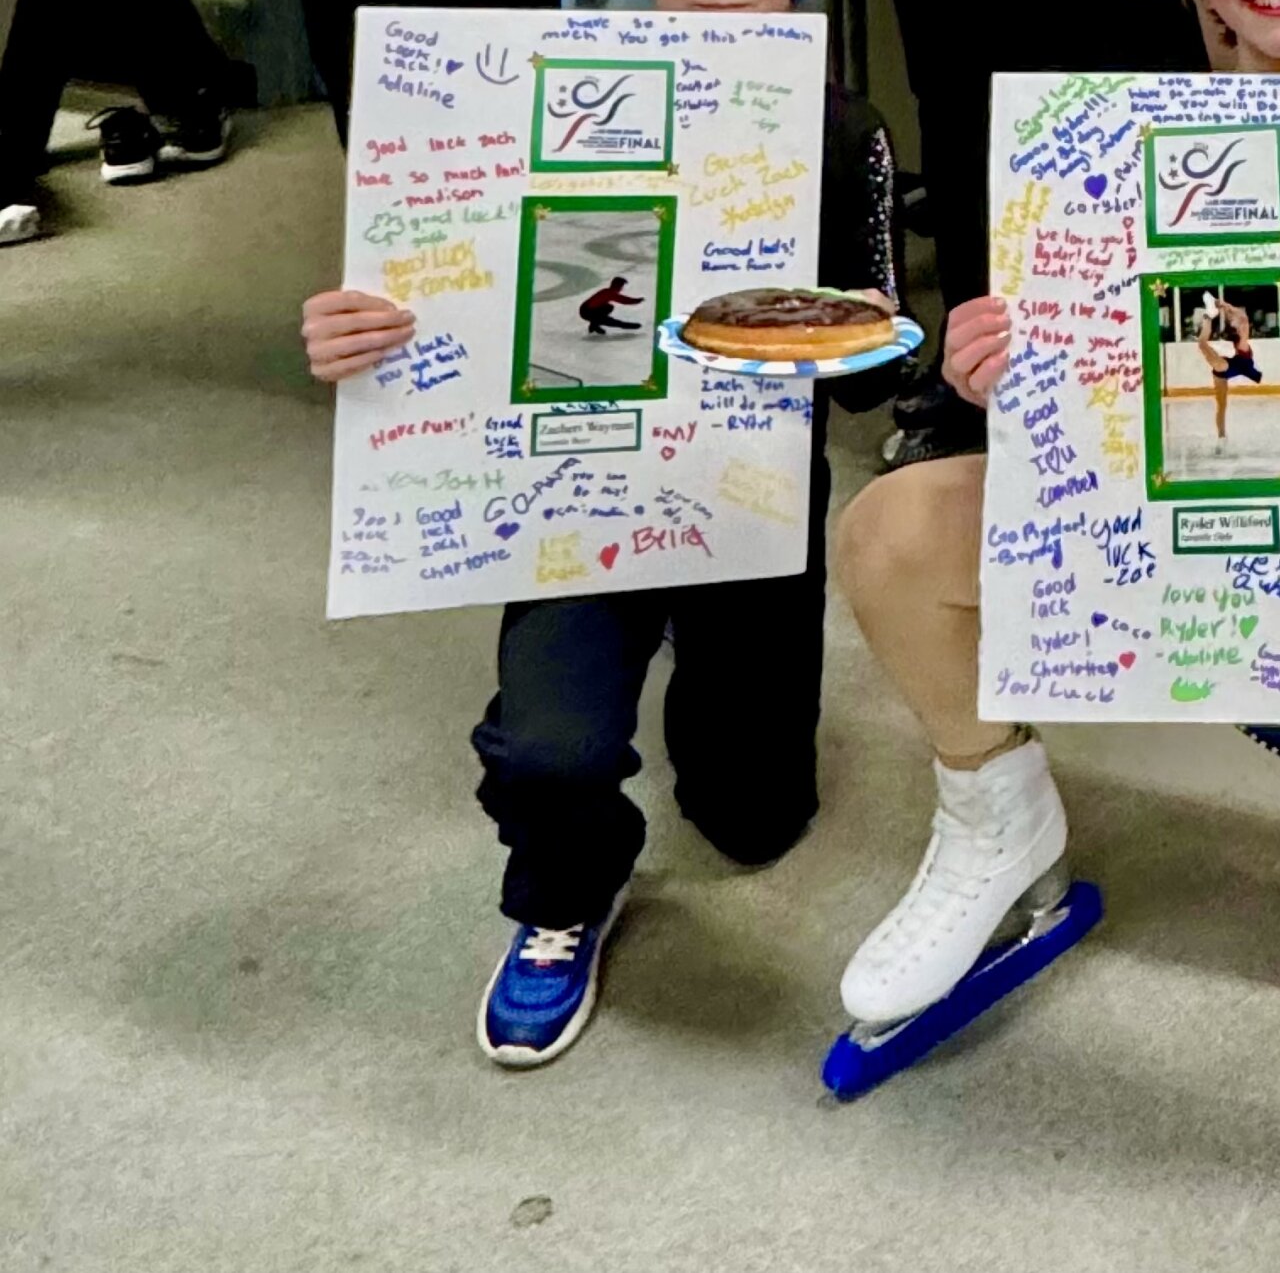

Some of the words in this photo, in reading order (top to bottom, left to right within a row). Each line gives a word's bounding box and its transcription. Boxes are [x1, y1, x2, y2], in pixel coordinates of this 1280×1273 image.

[619, 137, 661, 149] FINAL
[1235, 207, 1278, 220] FINAL
[1180, 517, 1214, 532] Ryder
